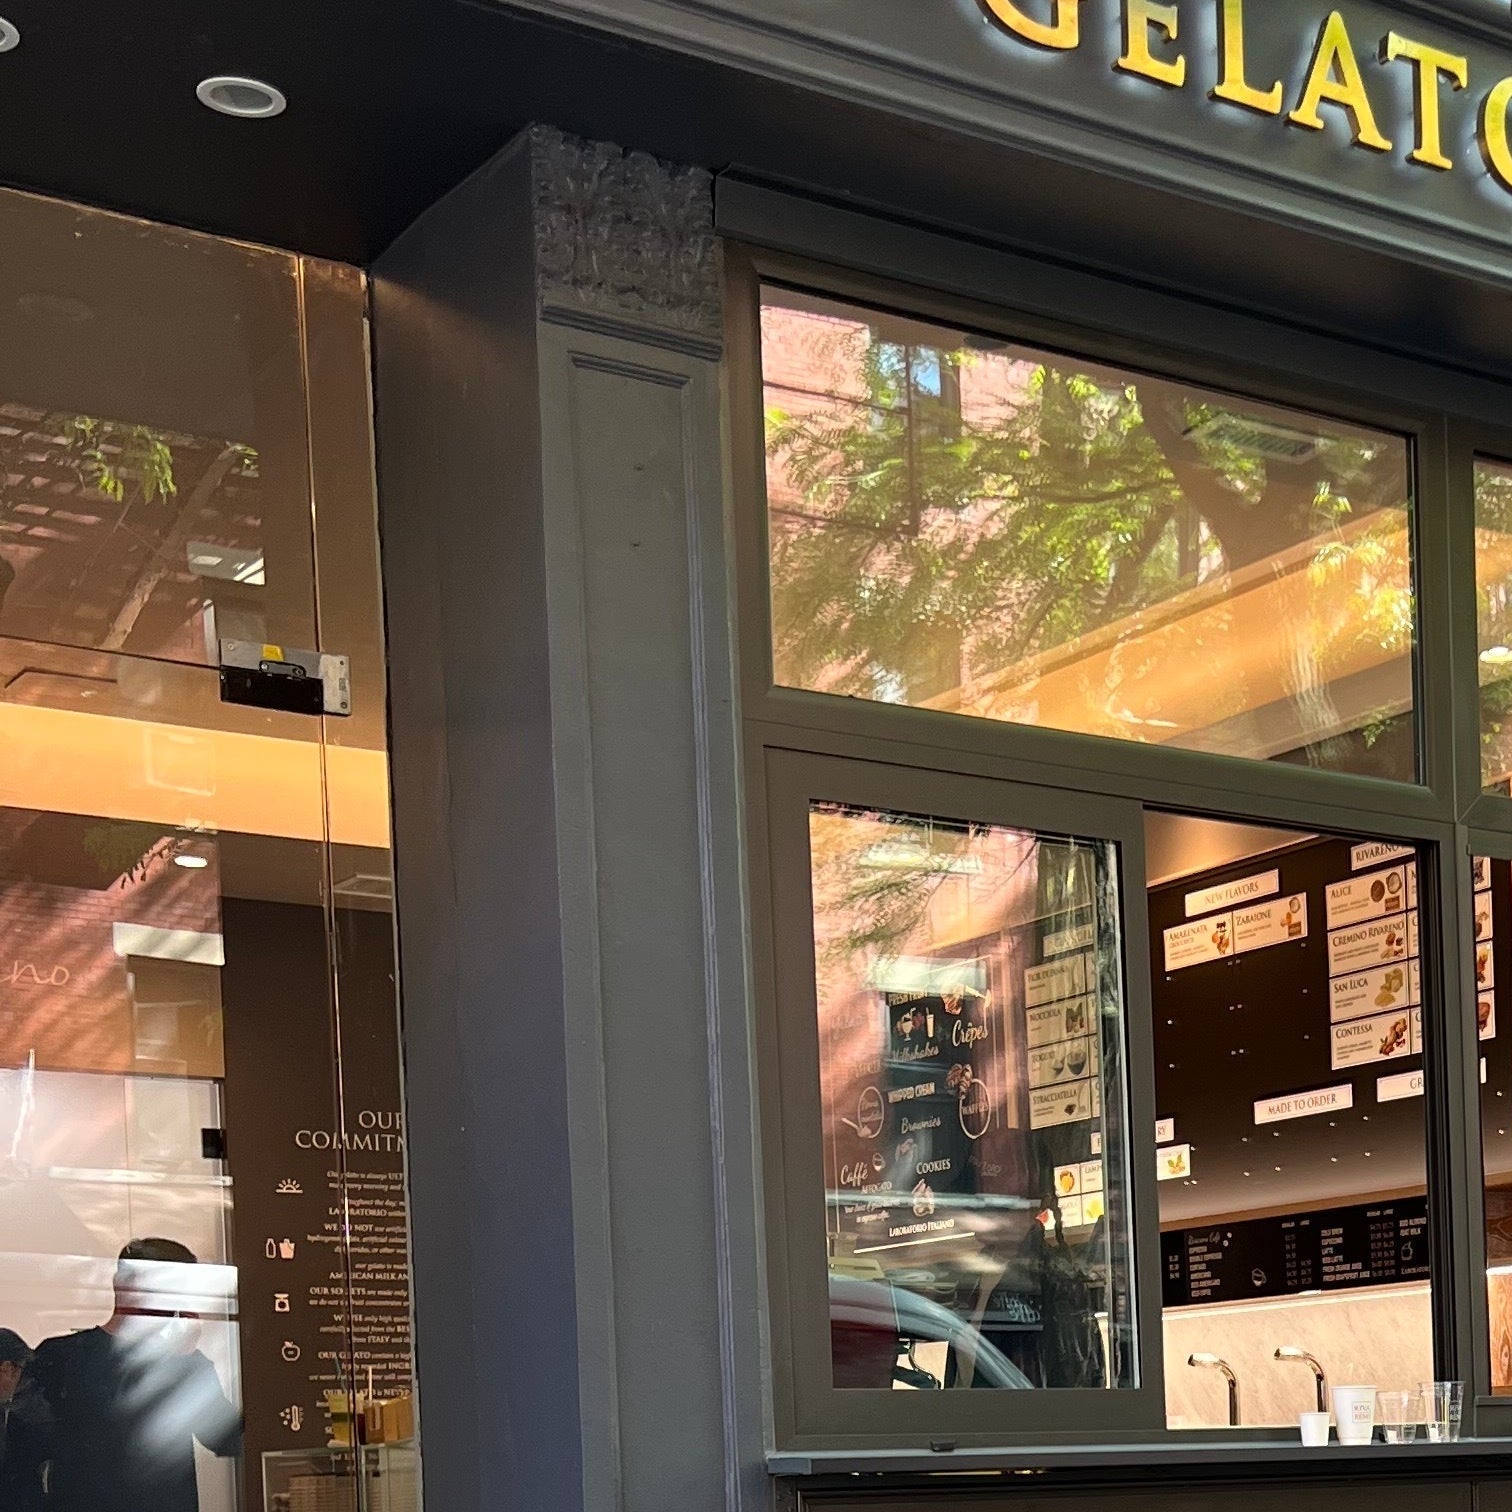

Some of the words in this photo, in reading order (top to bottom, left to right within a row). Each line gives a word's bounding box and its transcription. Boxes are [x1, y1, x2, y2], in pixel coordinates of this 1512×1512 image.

[1225, 881, 1259, 898] FLAVORS
[1331, 885, 1351, 898] ALICE
[1334, 983, 1348, 993] SAN
[1350, 978, 1368, 990] LUCA
[1336, 1024, 1373, 1039] CONTESSA
[1267, 1101, 1292, 1115] MADE
[1293, 1099, 1306, 1111] TO
[1307, 1093, 1337, 1109] ORDER
[916, 1158, 951, 1175] COOKIES
